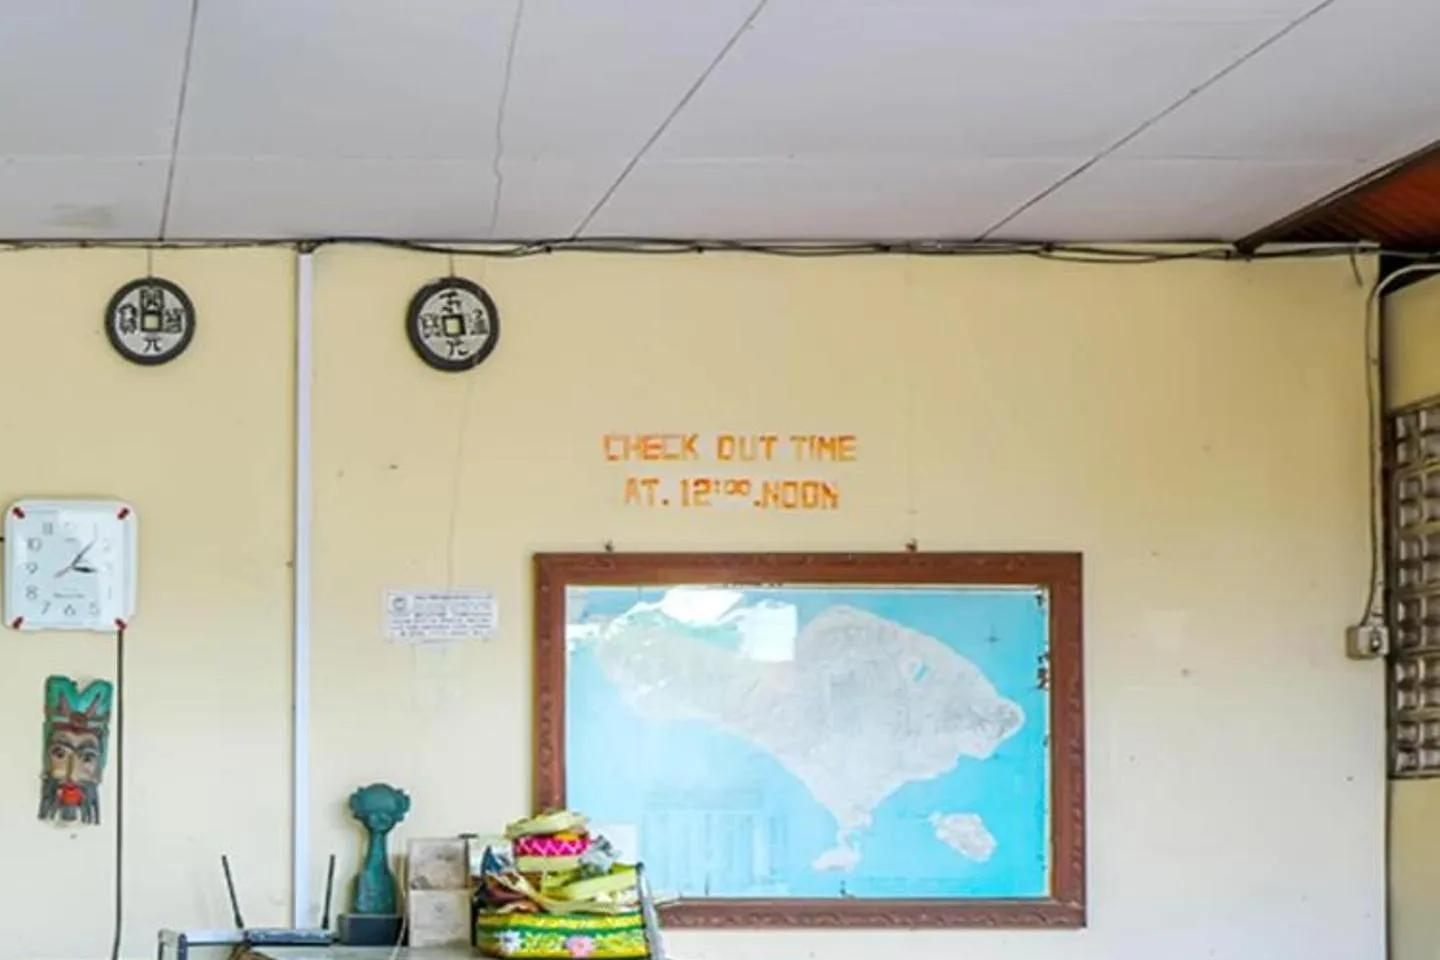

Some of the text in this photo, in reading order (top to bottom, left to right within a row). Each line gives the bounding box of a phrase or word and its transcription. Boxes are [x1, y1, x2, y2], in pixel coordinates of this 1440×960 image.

[603, 433, 857, 462] CHECK OUT TIME
